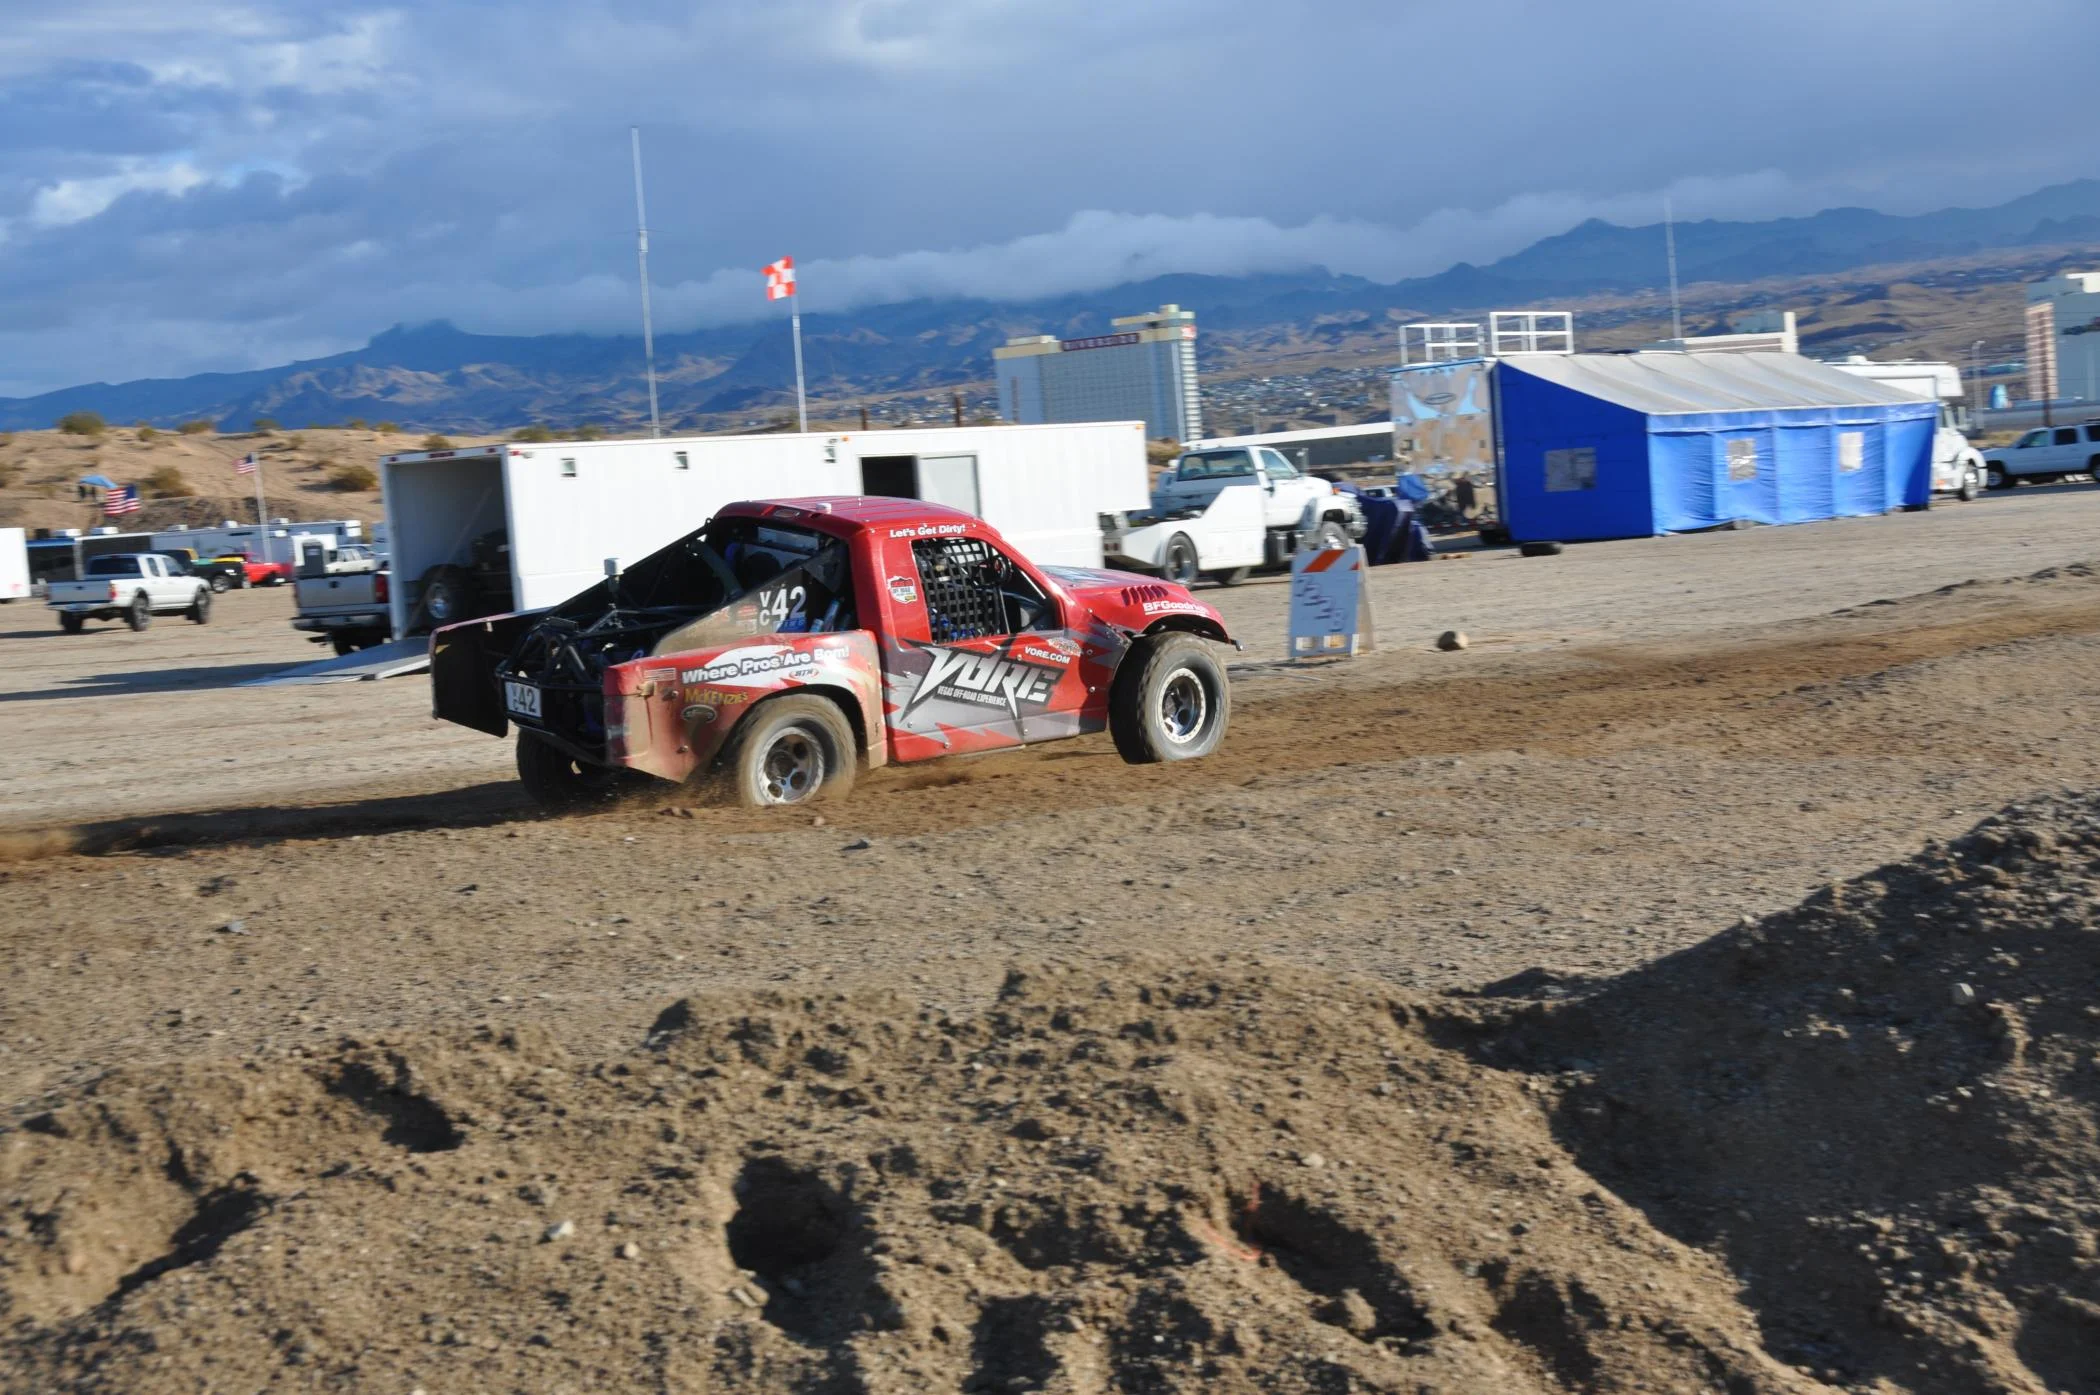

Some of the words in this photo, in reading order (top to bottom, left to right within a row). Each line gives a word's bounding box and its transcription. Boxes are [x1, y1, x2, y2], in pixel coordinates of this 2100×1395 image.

[889, 528, 916, 538] Let's
[918, 526, 937, 536] Get
[938, 524, 966, 534] Dirty!
[771, 586, 807, 624] 42
[682, 664, 738, 684] Where
[741, 656, 781, 674] Pros
[783, 652, 811, 666] Are
[1024, 645, 1071, 665] VORE.COM
[911, 645, 1059, 720] VORE
[518, 687, 537, 713] 42
[937, 685, 954, 697] VEGAS
[976, 693, 1007, 707] EXPERIENCE
